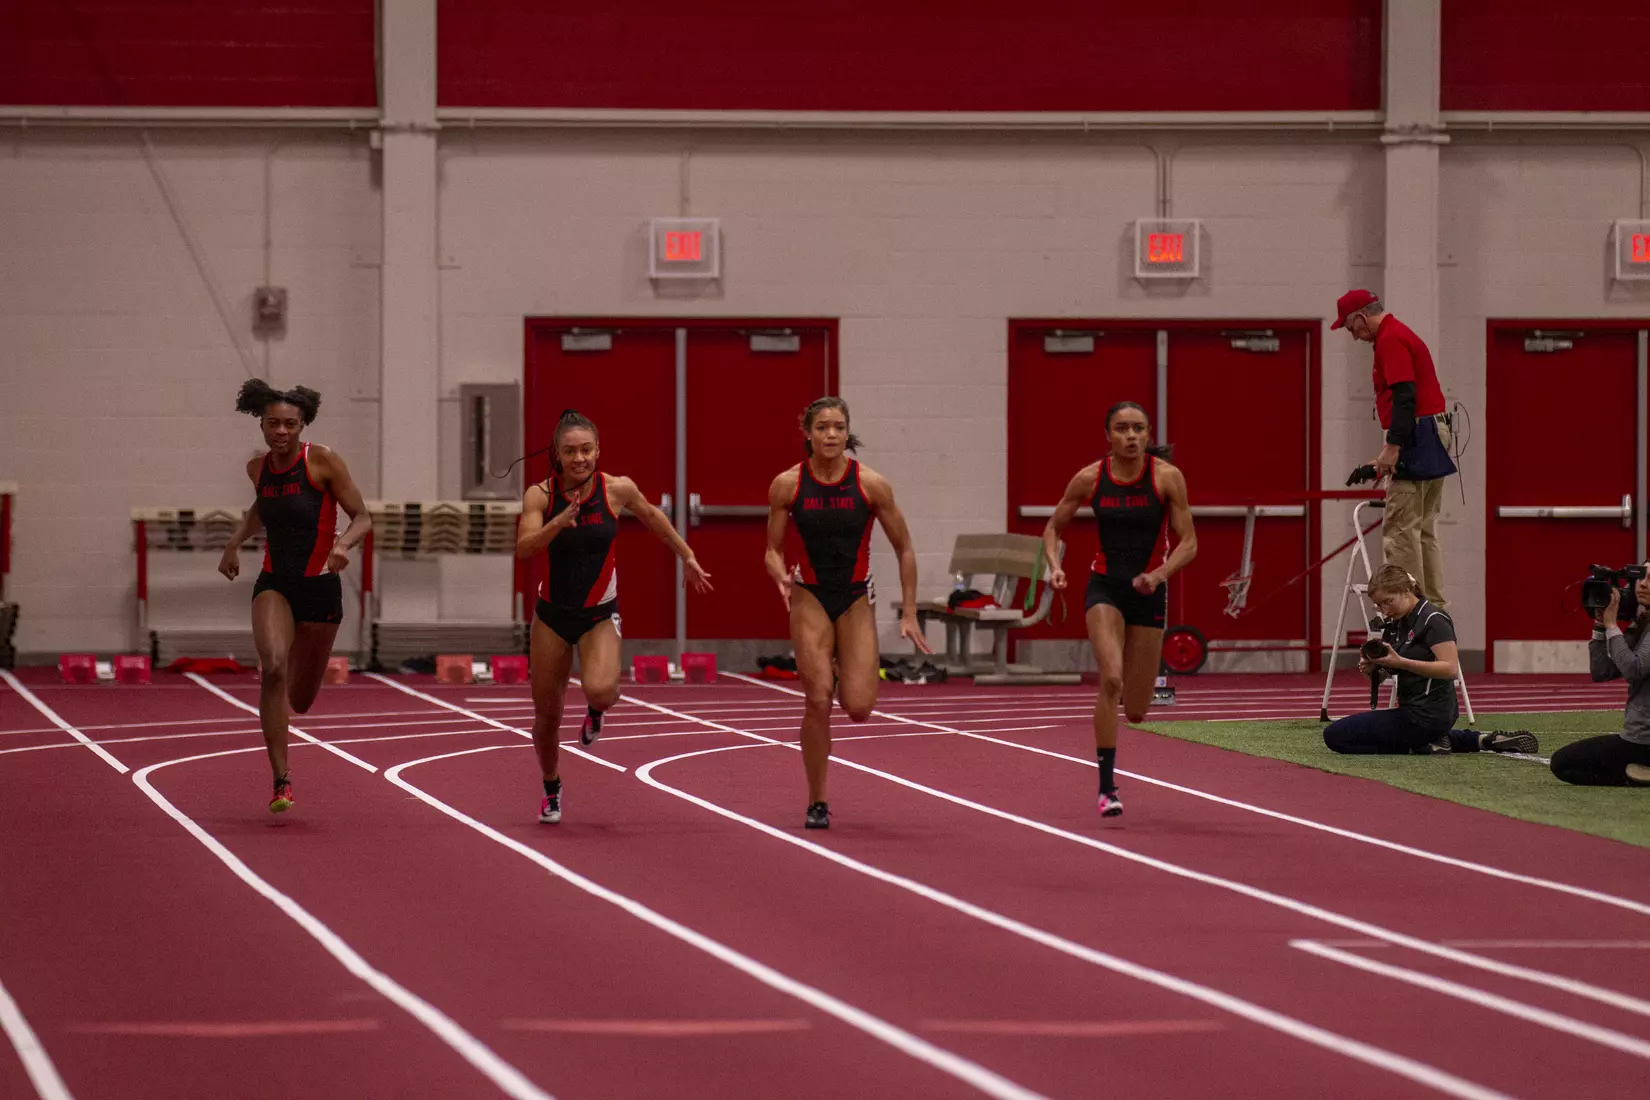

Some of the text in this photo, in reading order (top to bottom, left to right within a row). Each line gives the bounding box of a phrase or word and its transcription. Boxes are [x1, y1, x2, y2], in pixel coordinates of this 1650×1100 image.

[666, 232, 701, 260] EXIT
[1148, 233, 1183, 262] EXIT
[804, 496, 855, 510] BALL STATE
